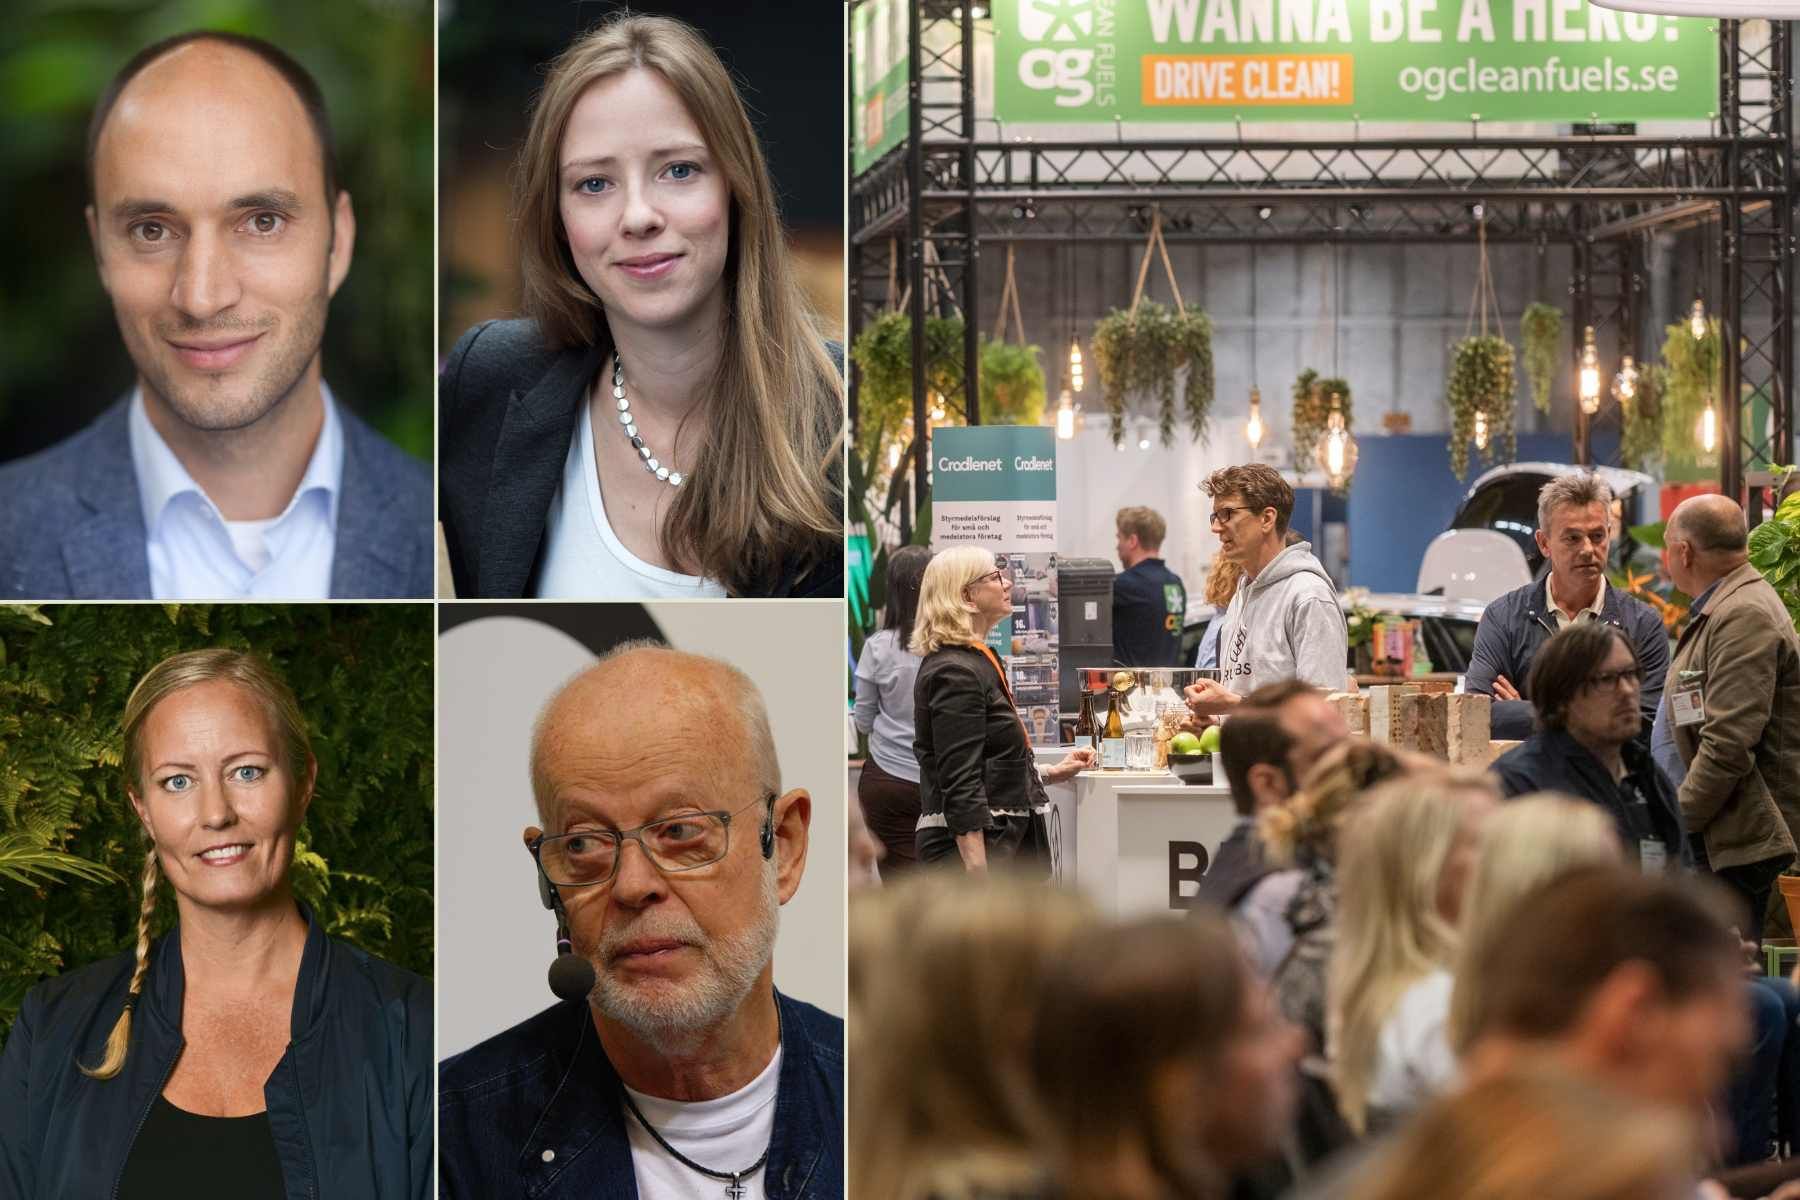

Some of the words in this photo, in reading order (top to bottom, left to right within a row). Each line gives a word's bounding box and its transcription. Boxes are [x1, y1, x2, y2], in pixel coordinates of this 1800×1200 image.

[1146, 0, 1353, 43] WANNA
[1369, 0, 1442, 43] BE
[1457, 0, 1496, 43] A
[1018, 47, 1095, 107] og
[1095, 44, 1116, 106] FUELS
[1154, 61, 1236, 99] DRIVE
[1242, 61, 1341, 99] CLEAN!
[1399, 56, 1679, 101] ogcleanfuels.se
[938, 456, 1003, 472] Cradlenet
[1014, 456, 1054, 472] Cradlenet
